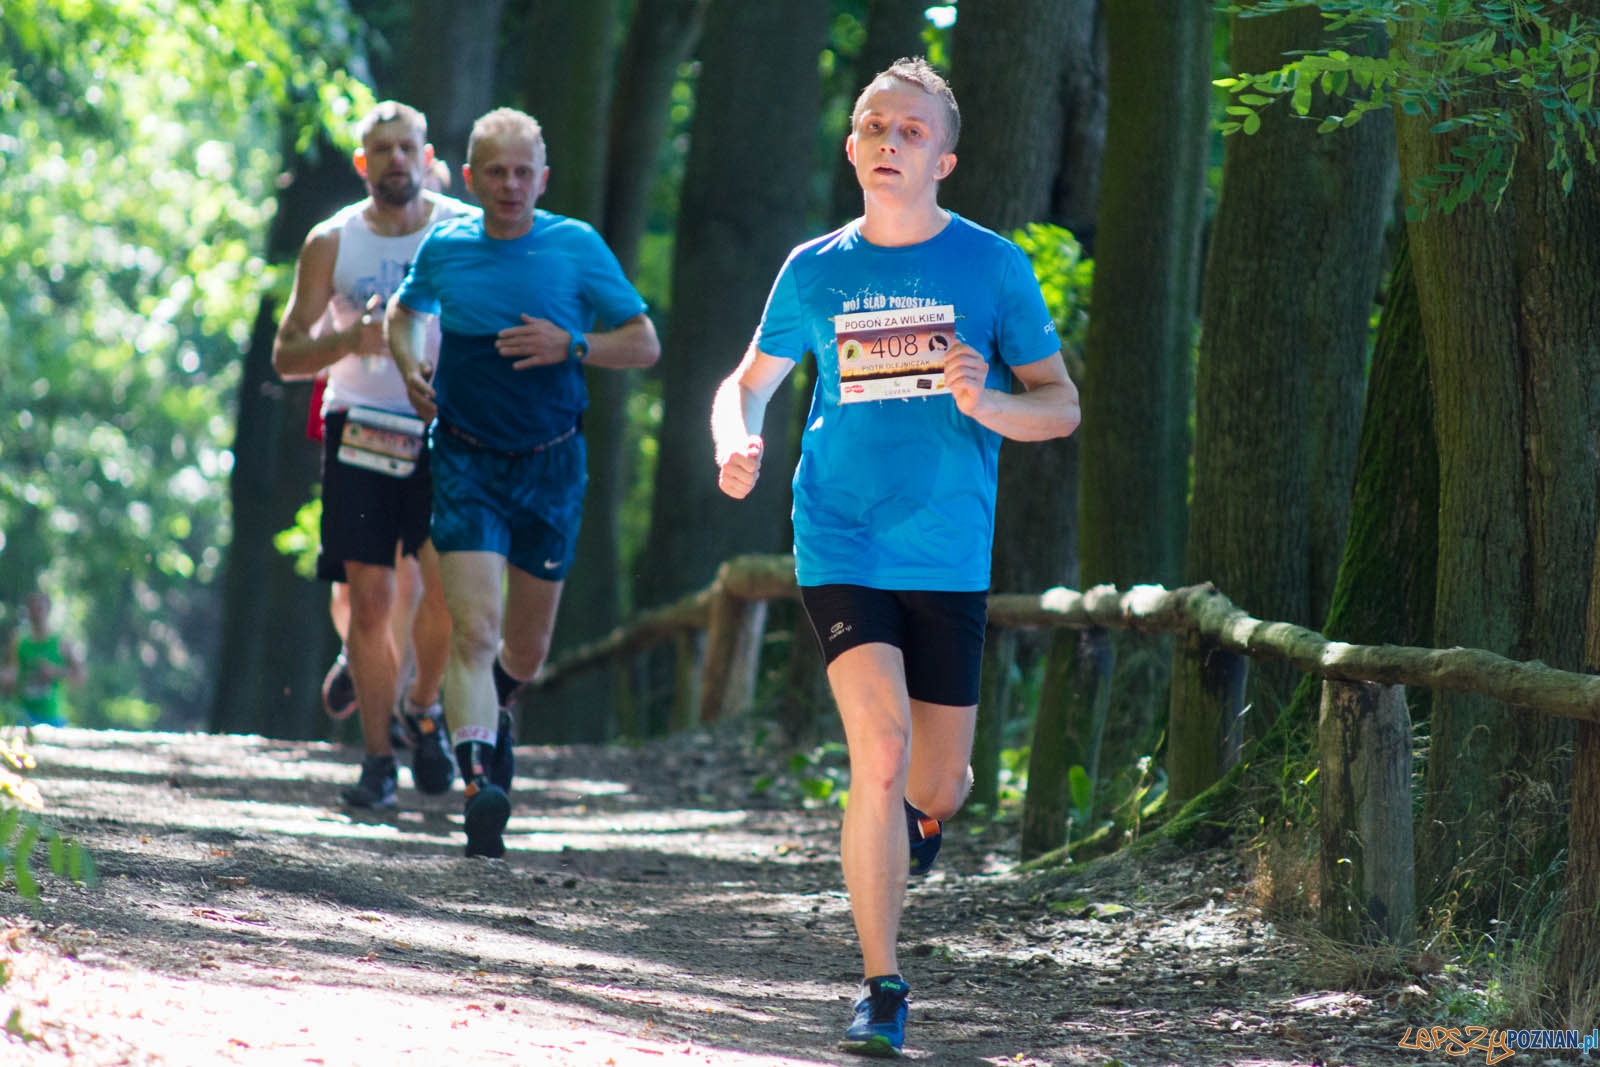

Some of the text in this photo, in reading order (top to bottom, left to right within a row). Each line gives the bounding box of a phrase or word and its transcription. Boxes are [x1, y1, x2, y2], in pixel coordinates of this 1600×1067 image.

[884, 318, 898, 327] ZA
[900, 313, 945, 325] WILKIEM
[870, 334, 919, 359] 408
[862, 364, 884, 372] PIOTR
